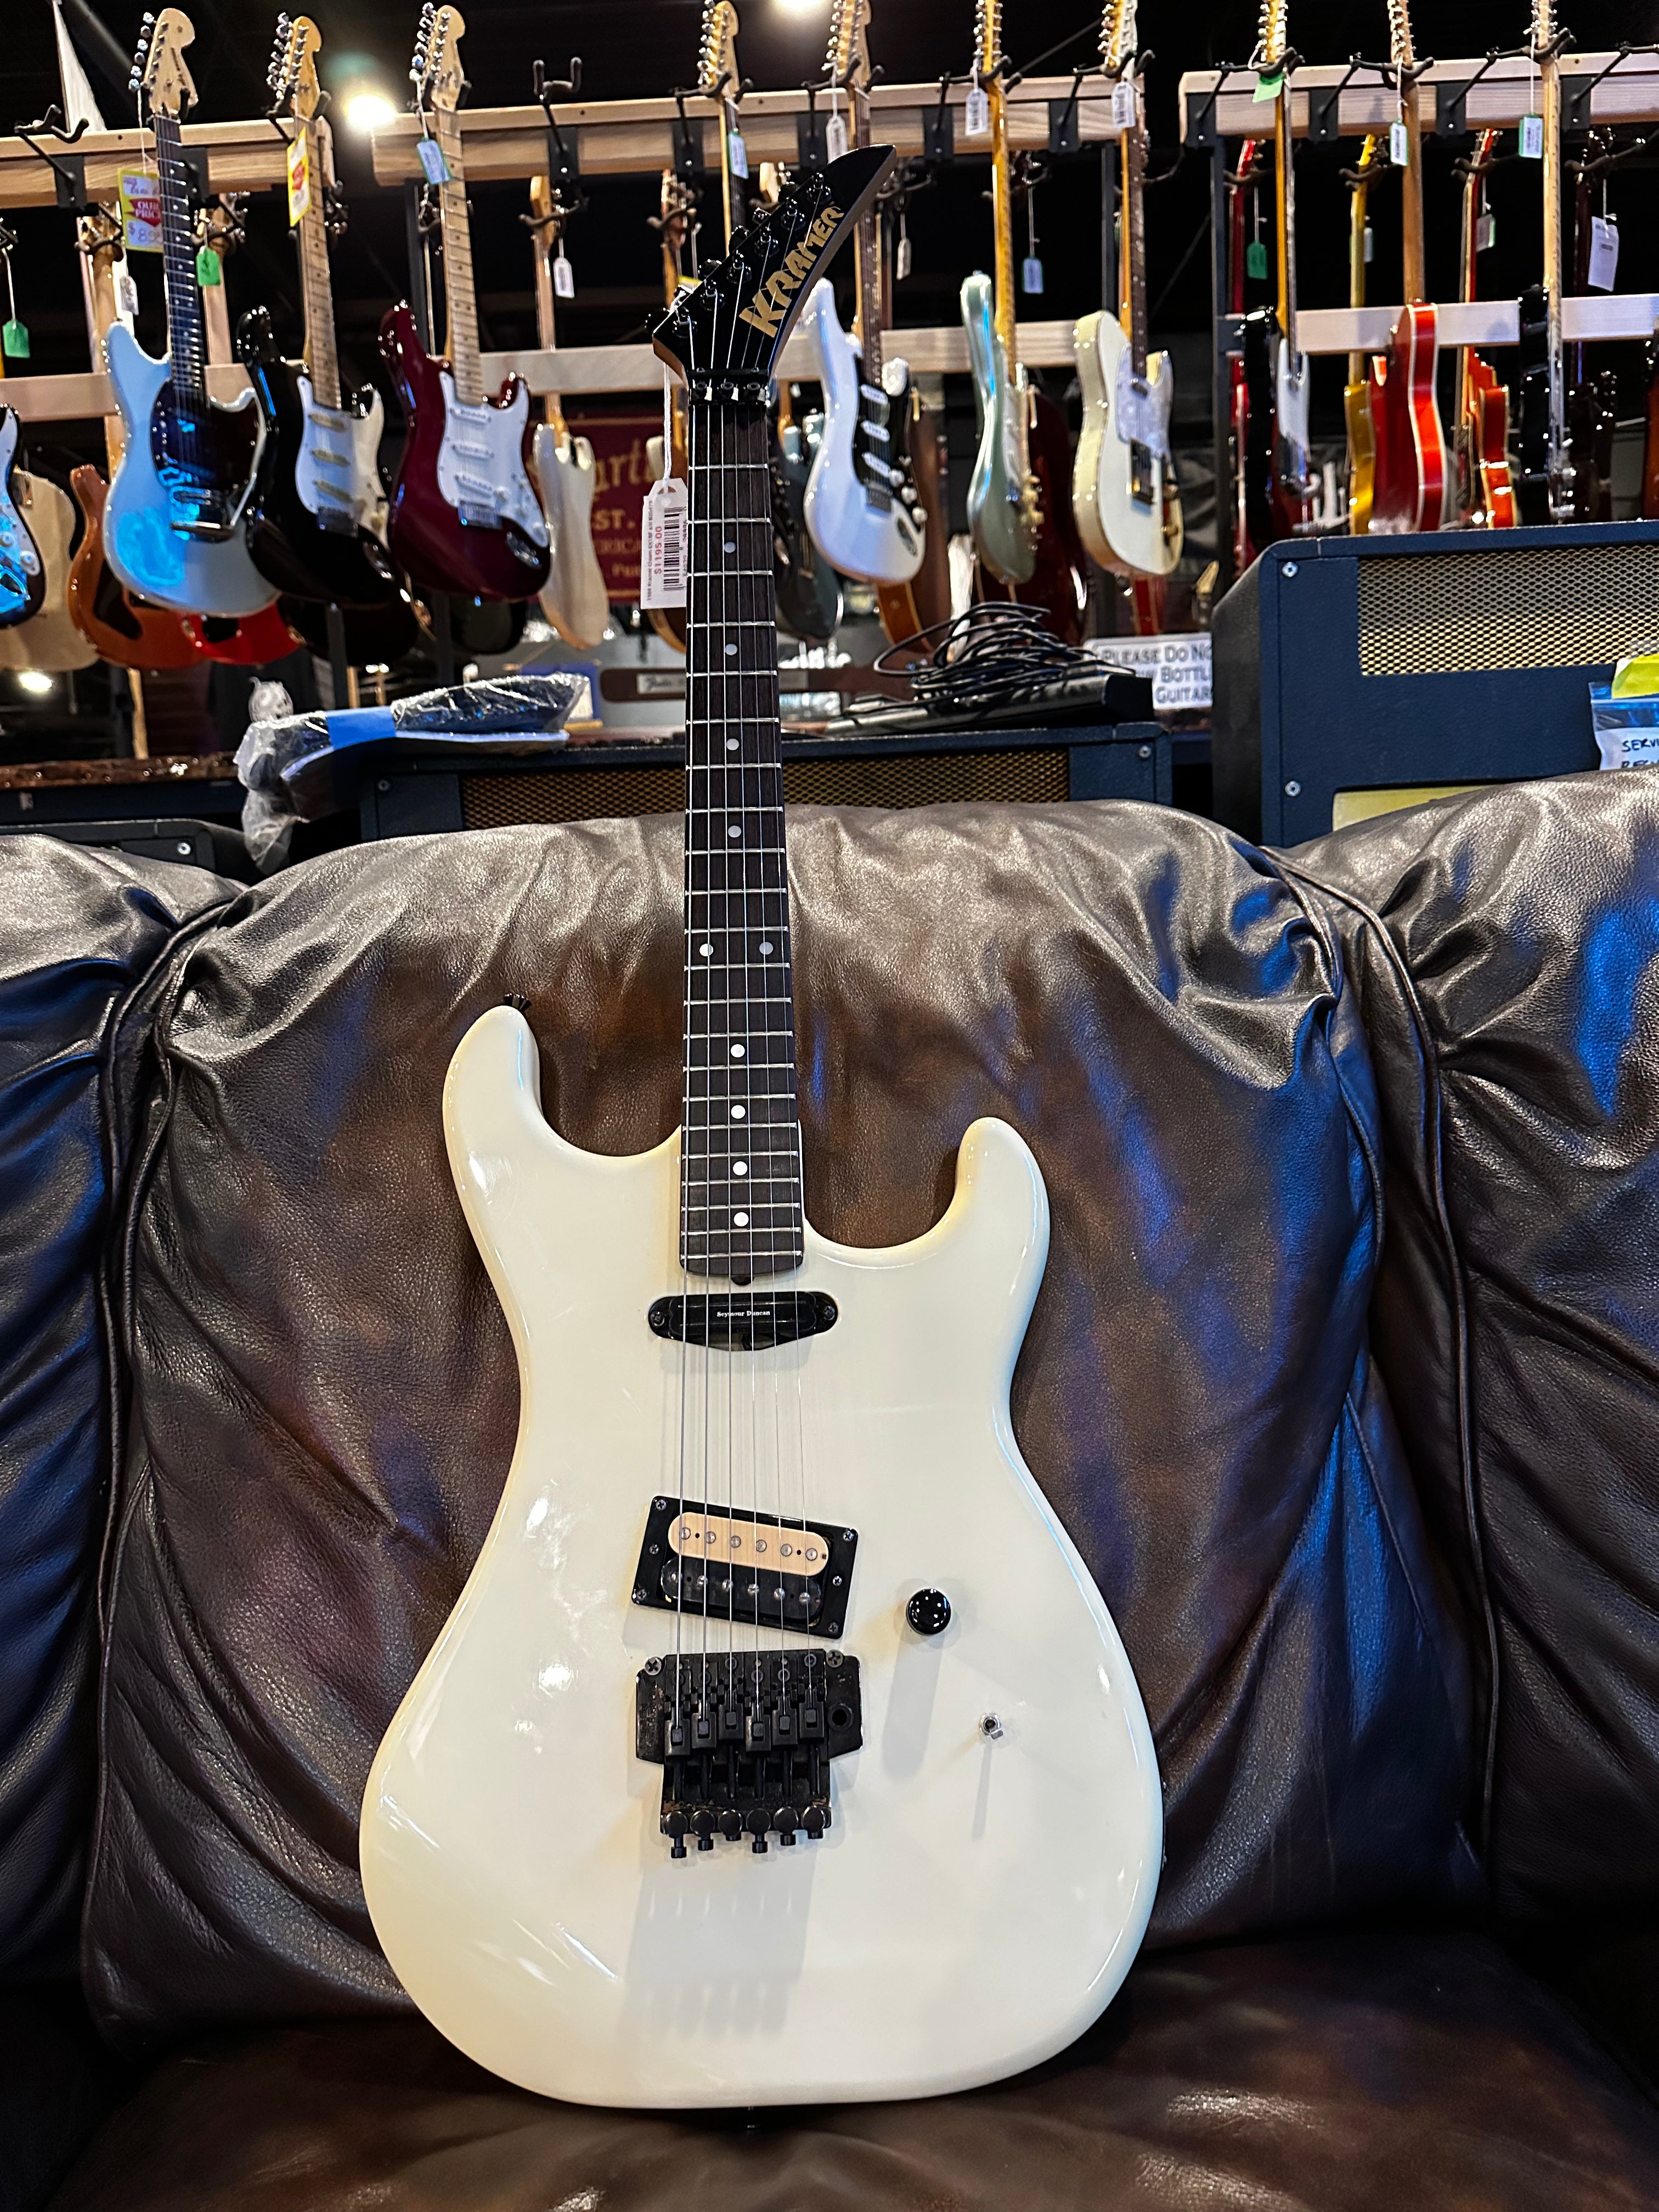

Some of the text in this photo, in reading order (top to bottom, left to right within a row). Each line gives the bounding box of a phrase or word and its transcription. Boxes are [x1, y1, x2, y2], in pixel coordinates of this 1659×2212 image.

[738, 206, 844, 338] KRAMER
[591, 509, 636, 531] ST.
[1101, 647, 1161, 665] PLEASE
[1191, 642, 1211, 661] NO
[1160, 665, 1211, 683] BOTTL
[1621, 738, 1659, 753] SERVI
